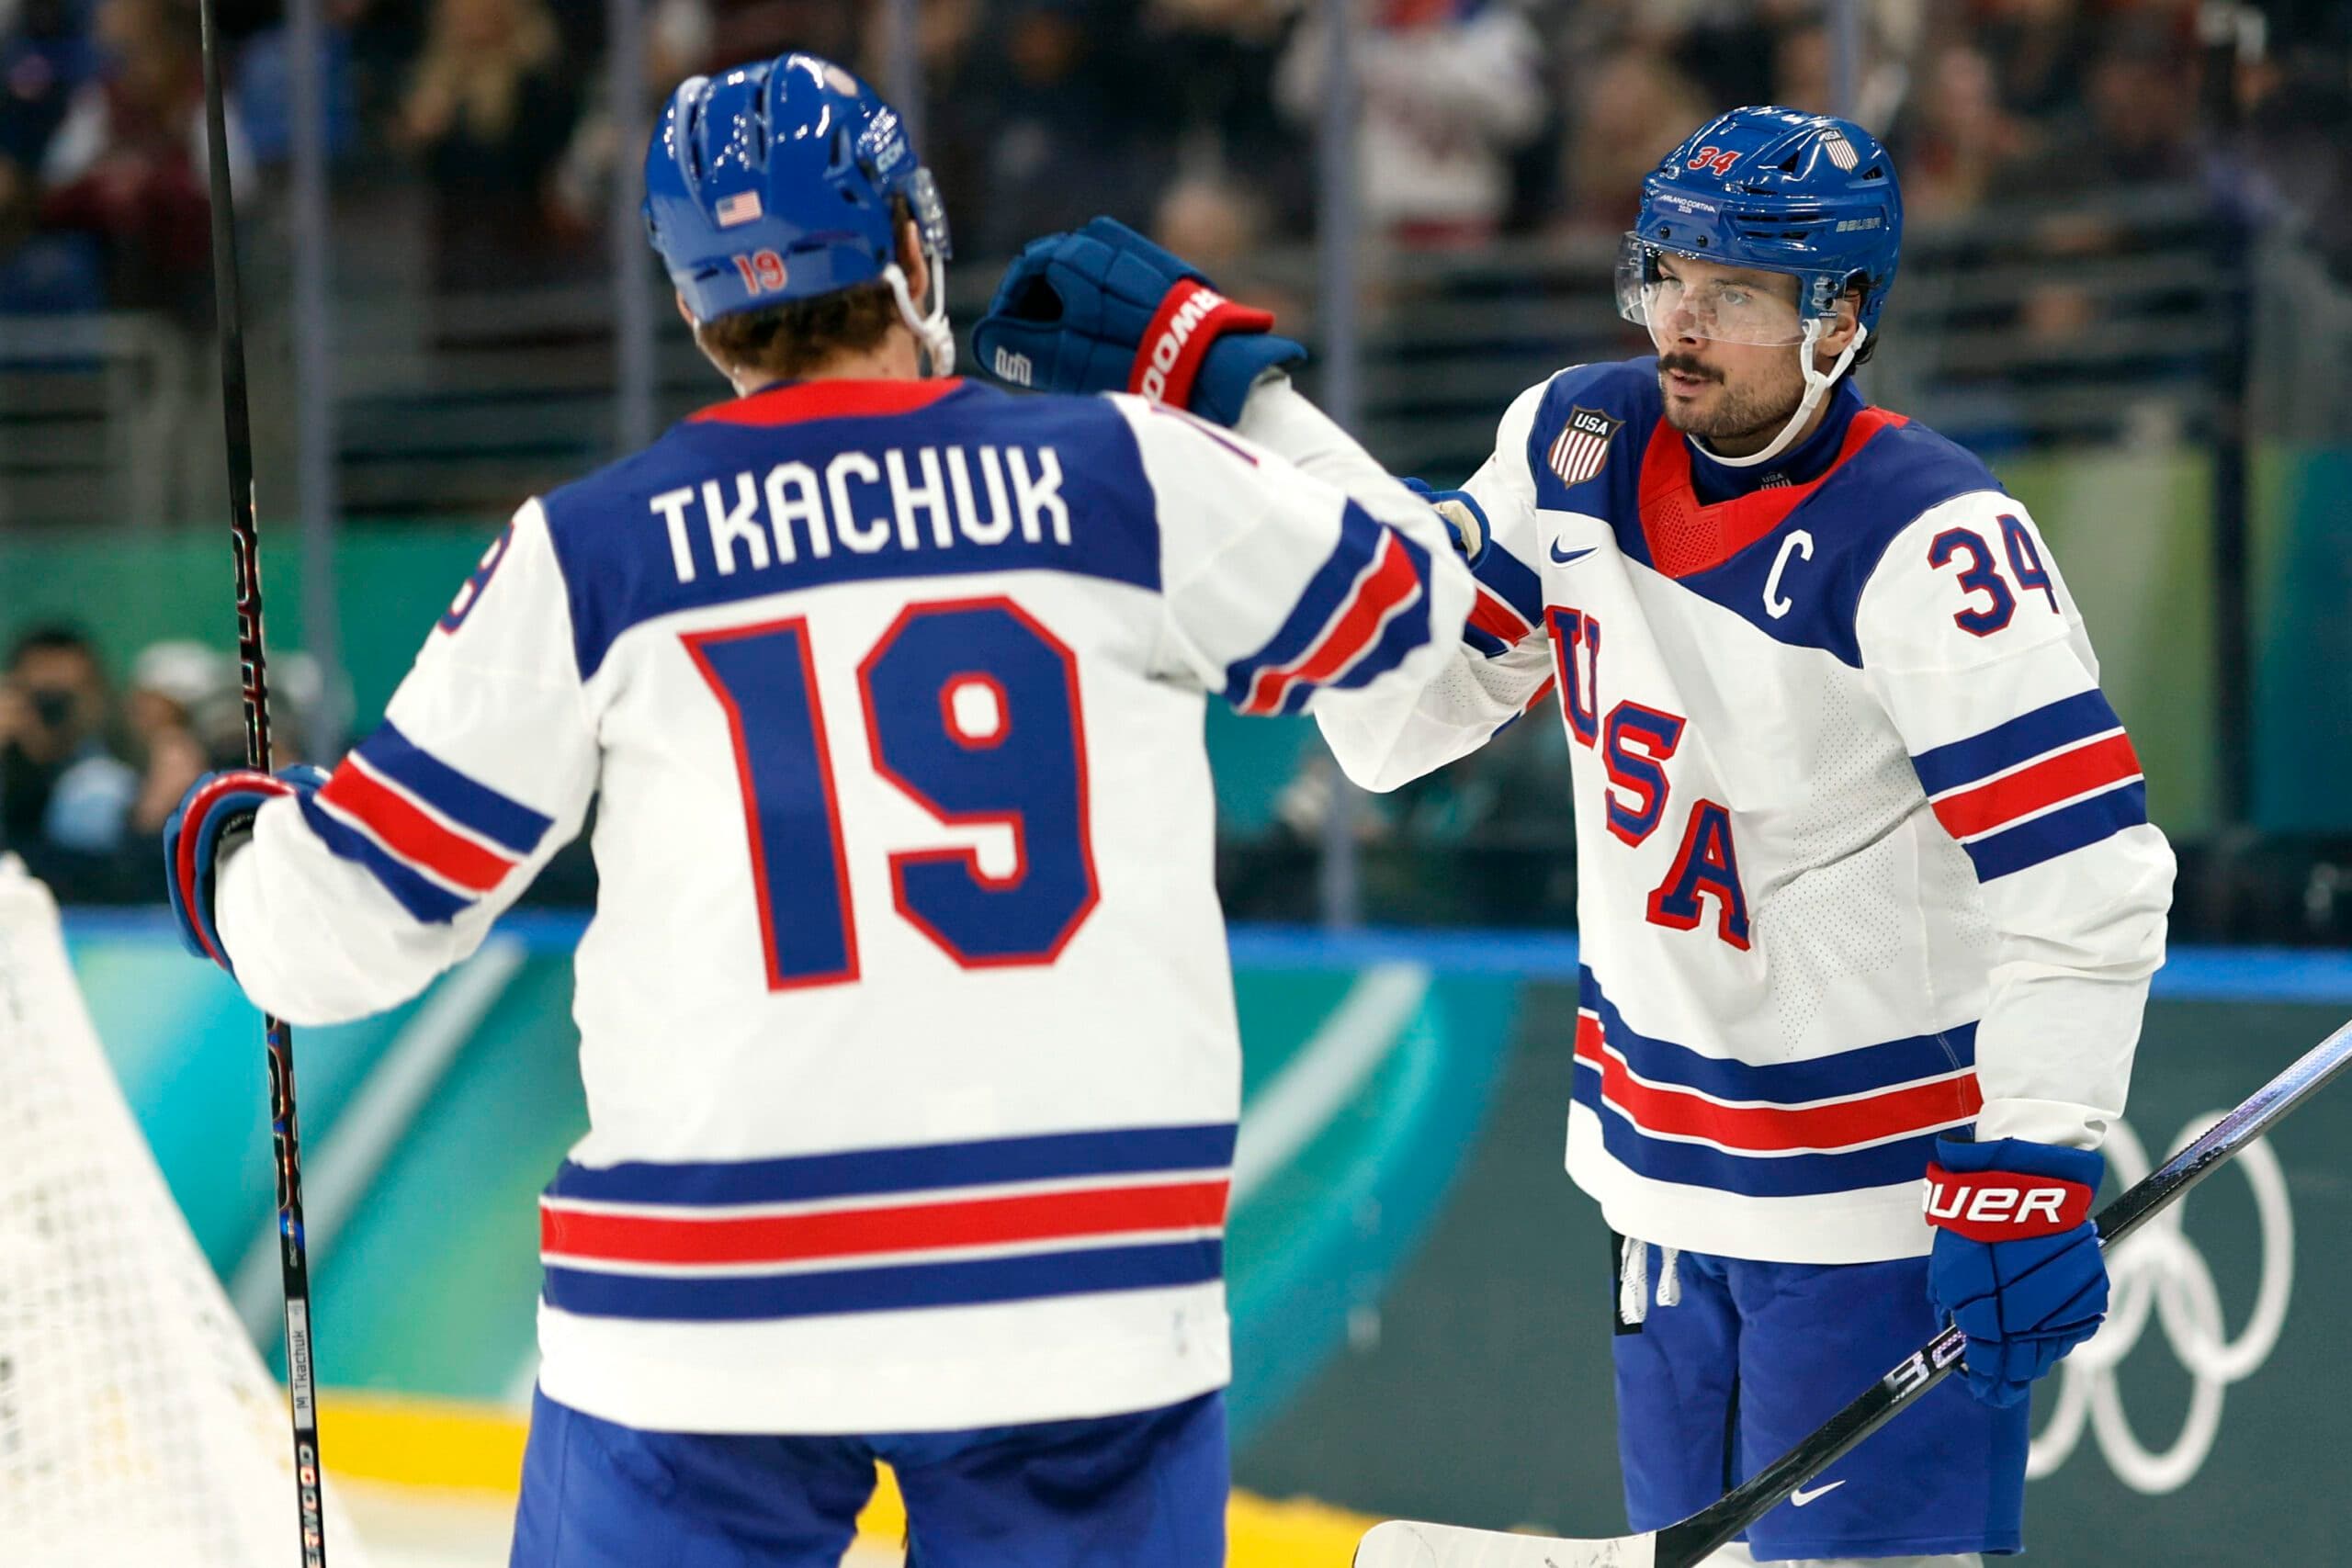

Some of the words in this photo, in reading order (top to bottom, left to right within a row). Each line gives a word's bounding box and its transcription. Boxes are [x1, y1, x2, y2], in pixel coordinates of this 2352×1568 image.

[1825, 130, 1842, 141] USA
[1688, 146, 1743, 176] 34
[1659, 194, 1686, 206] MILANO
[1686, 199, 1716, 212] CORTINA
[1836, 217, 1882, 232] BAUER
[731, 249, 787, 297] 19
[1574, 413, 1609, 435] USA
[1761, 473, 1784, 483] USA
[650, 446, 1071, 583] TKACHUK
[1763, 529, 1814, 619] C
[1928, 513, 2060, 637] 34
[676, 593, 1101, 993] 19
[1544, 604, 1750, 952] USA
[293, 1330, 308, 1390] Tkachuk
[296, 1395, 309, 1409] M
